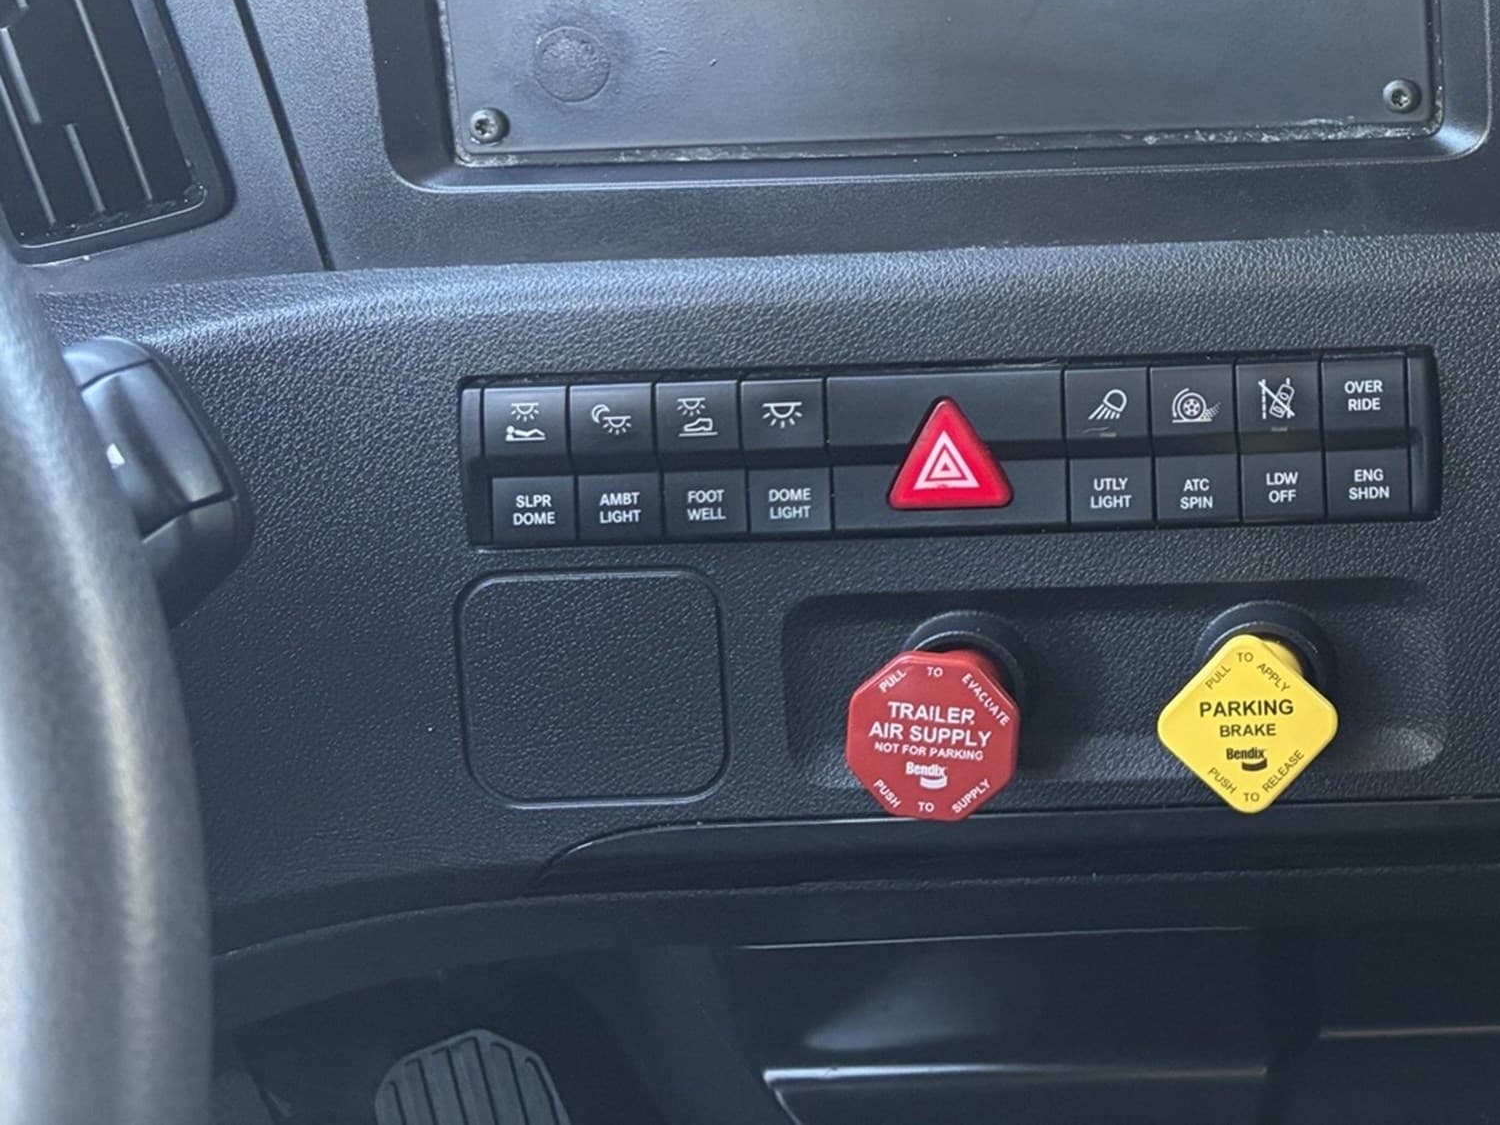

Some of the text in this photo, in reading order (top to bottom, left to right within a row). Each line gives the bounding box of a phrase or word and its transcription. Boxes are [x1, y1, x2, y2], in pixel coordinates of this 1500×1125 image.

[1344, 380, 1383, 395] OVER
[1347, 398, 1381, 412] RIDE
[1266, 472, 1299, 486] LDW
[1354, 469, 1384, 483] ENG
[1093, 478, 1128, 492] UTLY
[1183, 478, 1210, 492] ATC
[1348, 485, 1390, 500] SHDN
[515, 494, 552, 509] SLPR
[600, 491, 640, 506] AMBT
[687, 489, 725, 504] FOOT
[768, 487, 812, 502] DOME
[1090, 495, 1133, 509] LIGHT
[1179, 495, 1214, 509] SPIN
[1268, 489, 1297, 503] OFF
[513, 511, 556, 525] DOME
[599, 509, 642, 524] LIGHT
[687, 506, 727, 521] WELL
[769, 505, 811, 520] LIGHT
[1205, 652, 1291, 693] PULL TO APPLY
[878, 667, 1011, 726] PULL TO EVACUATE
[887, 701, 976, 725] TRAILER
[1199, 699, 1294, 717] PARKING
[868, 721, 992, 748] AIR SUPPLY
[1219, 723, 1277, 738] BRAKE
[874, 741, 984, 761] NOT FOR PARKING
[1226, 747, 1265, 760] Bendix
[905, 761, 947, 775] Bendix
[1208, 749, 1305, 802] PUSH TO RELEASE
[873, 778, 991, 814] PUSH TO SUPPLY
